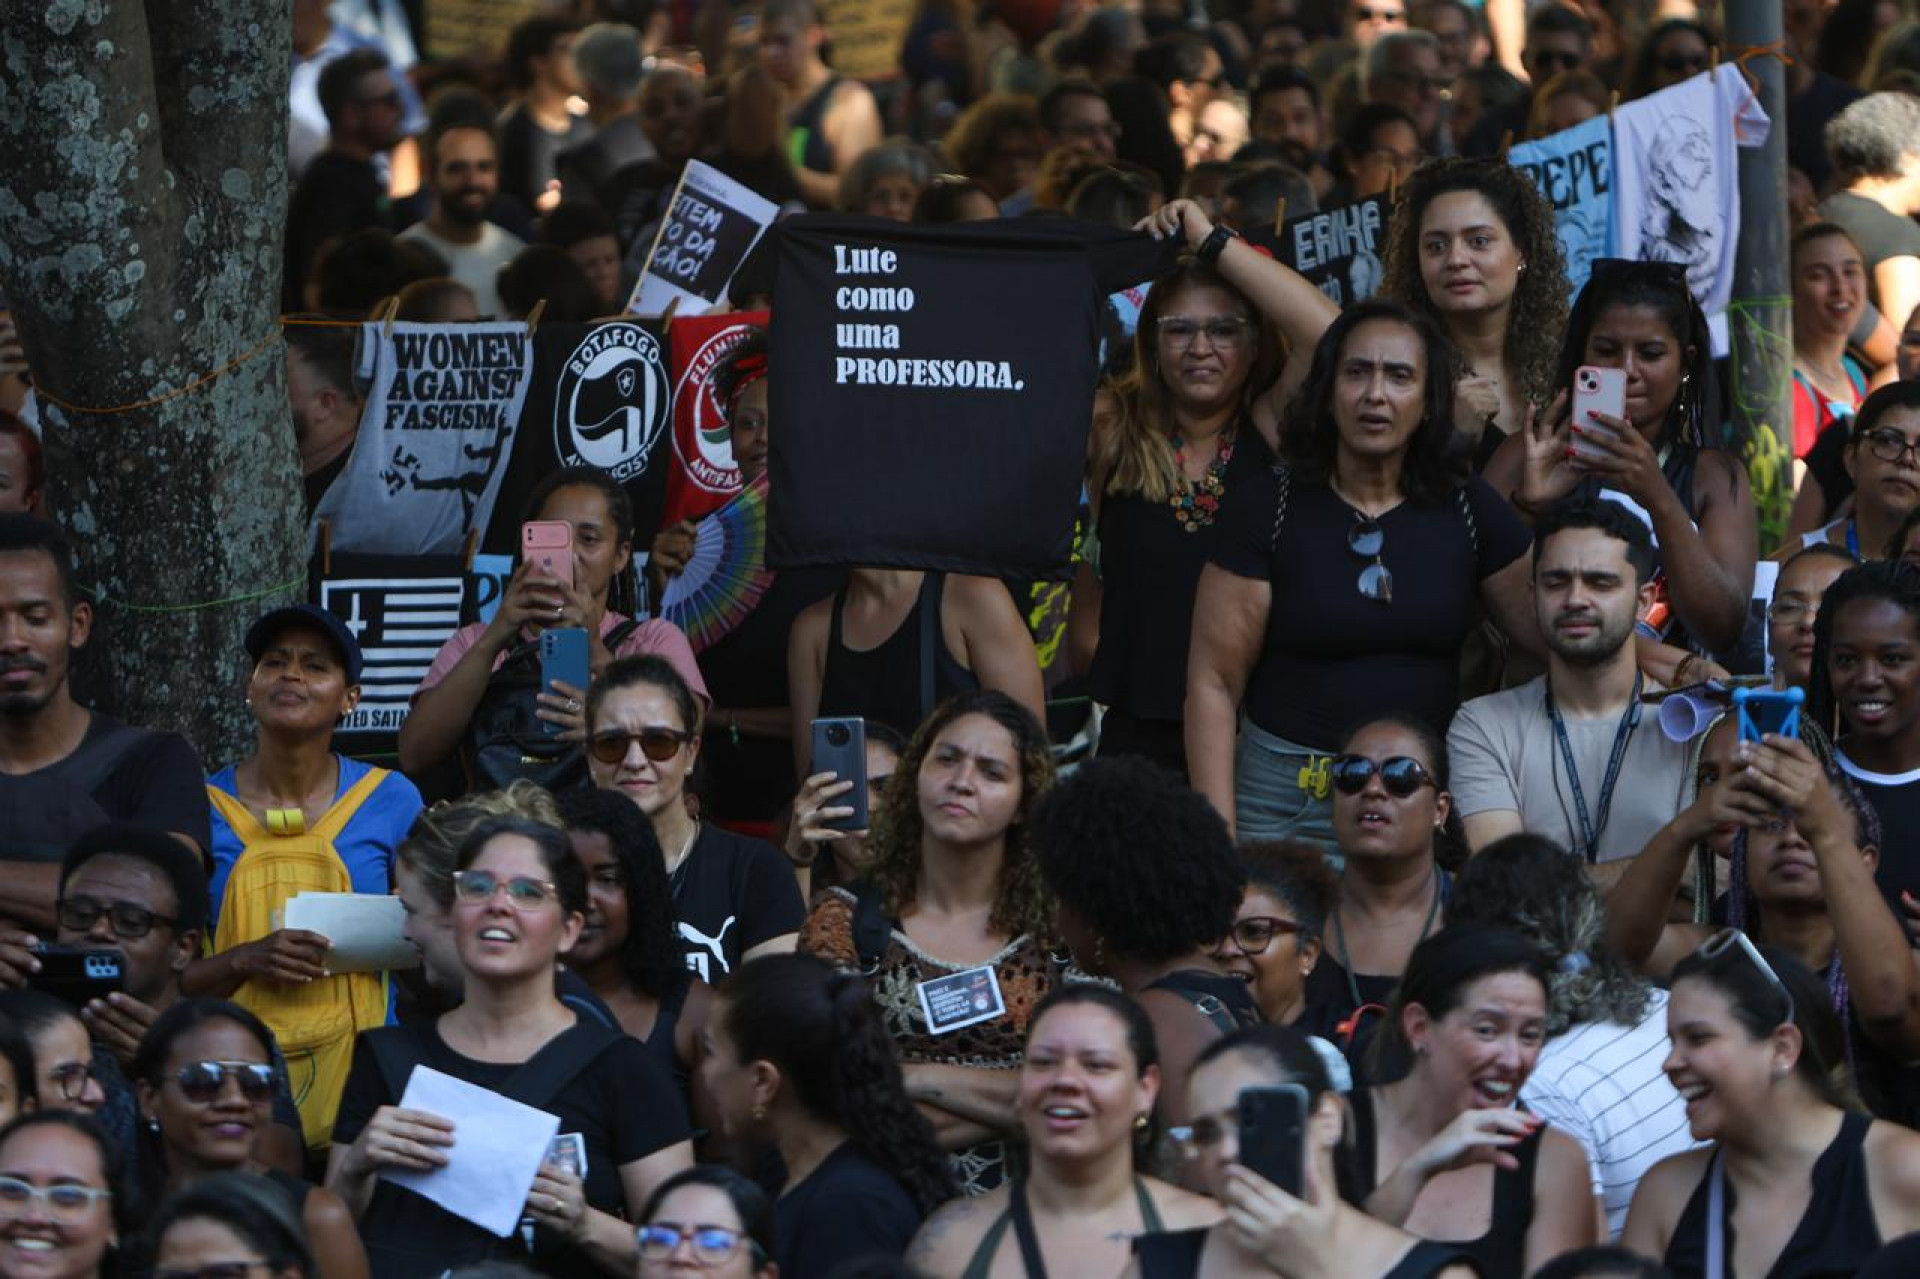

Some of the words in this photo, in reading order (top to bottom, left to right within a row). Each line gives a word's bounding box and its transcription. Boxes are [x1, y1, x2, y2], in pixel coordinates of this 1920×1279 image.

[684, 230, 717, 261] DA
[834, 245, 898, 274] Lute
[836, 286, 915, 311] como
[393, 333, 525, 369] WOMEN
[836, 323, 900, 349] uma
[570, 329, 660, 375] BOTAFOGO
[387, 369, 523, 401] AGAINST
[836, 356, 1025, 391] PROFESSORA.
[384, 402, 499, 430] FASCISM
